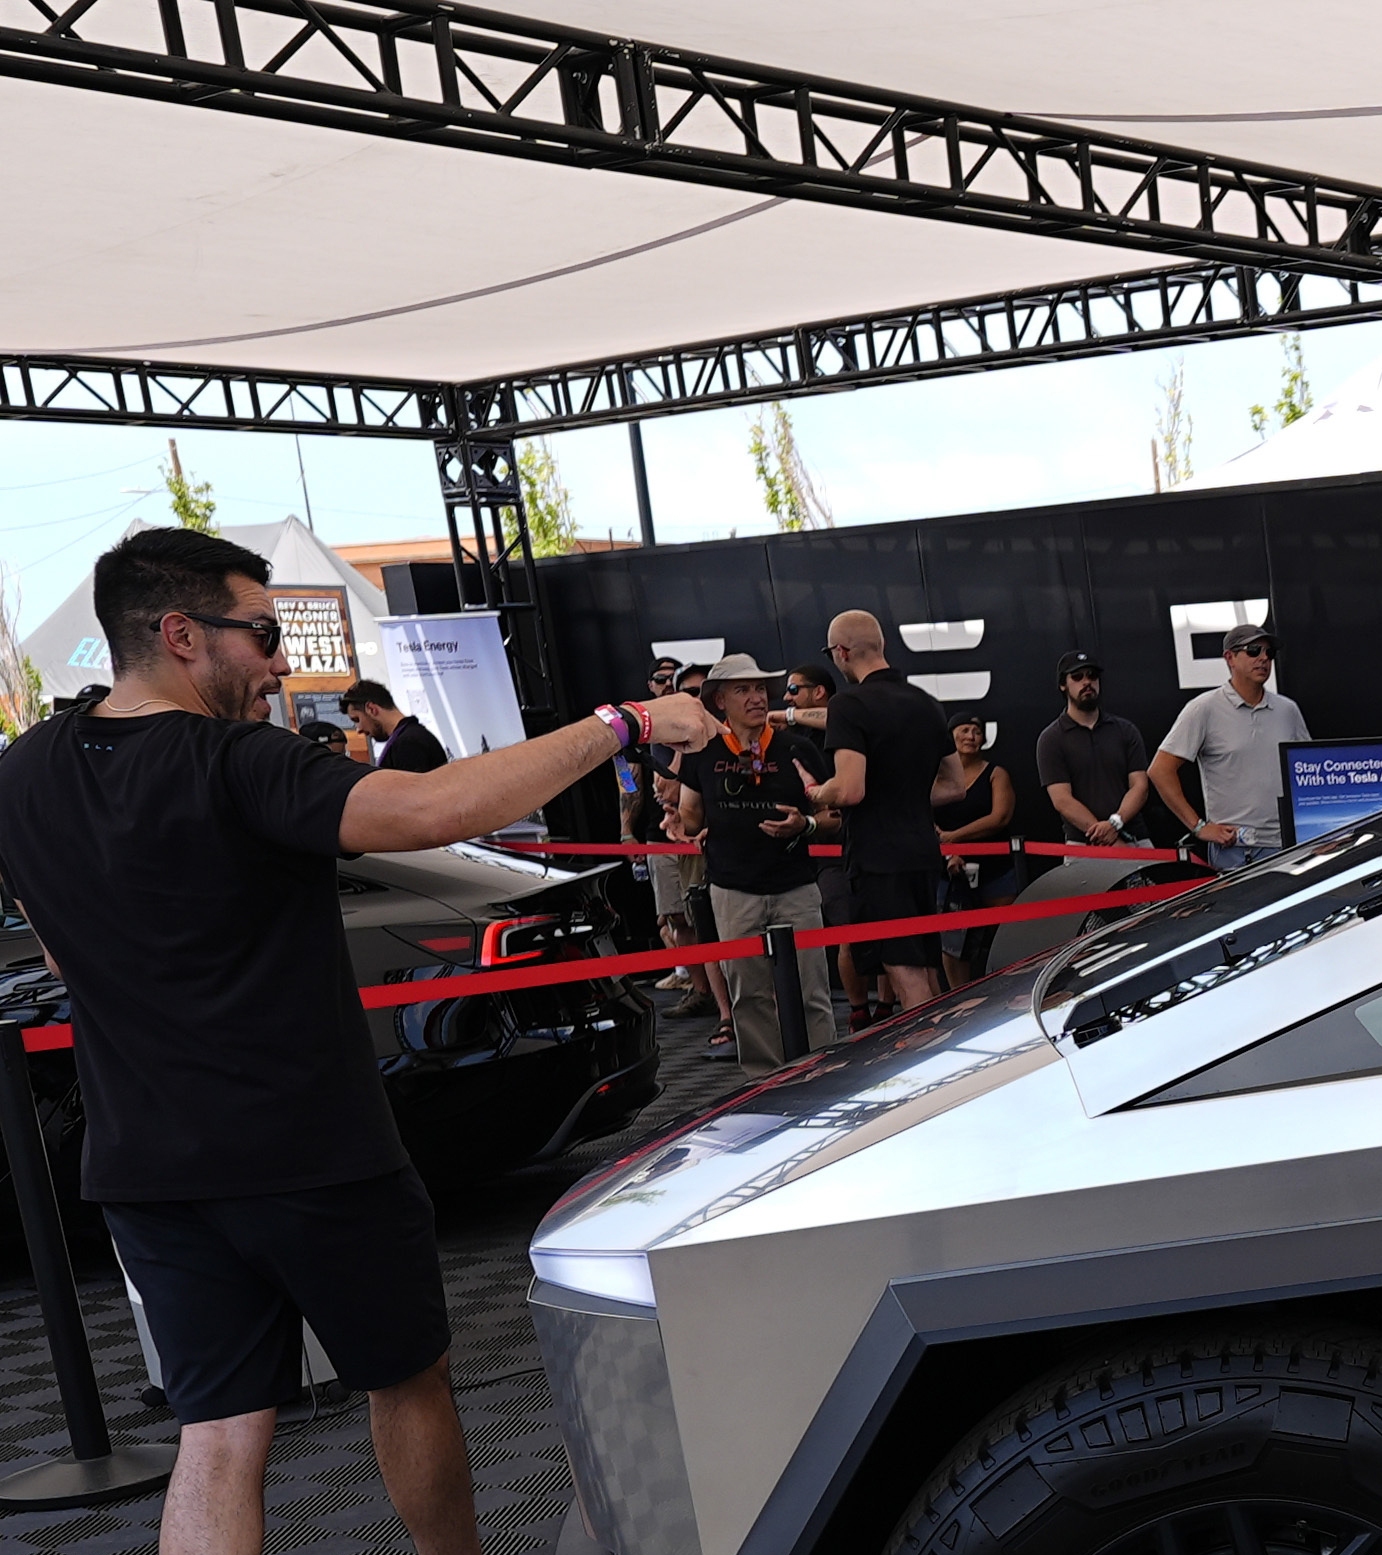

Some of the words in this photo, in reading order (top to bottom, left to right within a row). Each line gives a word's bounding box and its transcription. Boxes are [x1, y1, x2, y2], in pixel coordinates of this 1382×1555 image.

[280, 610, 339, 622] WAGNER
[281, 622, 340, 636] FAMILY
[284, 635, 343, 655] WEST
[424, 639, 459, 654] Energy
[287, 655, 347, 673] PLAZA
[1294, 761, 1321, 774] Stay
[1296, 774, 1325, 787] With
[1326, 772, 1346, 785] the
[1348, 771, 1378, 784] Tesla
